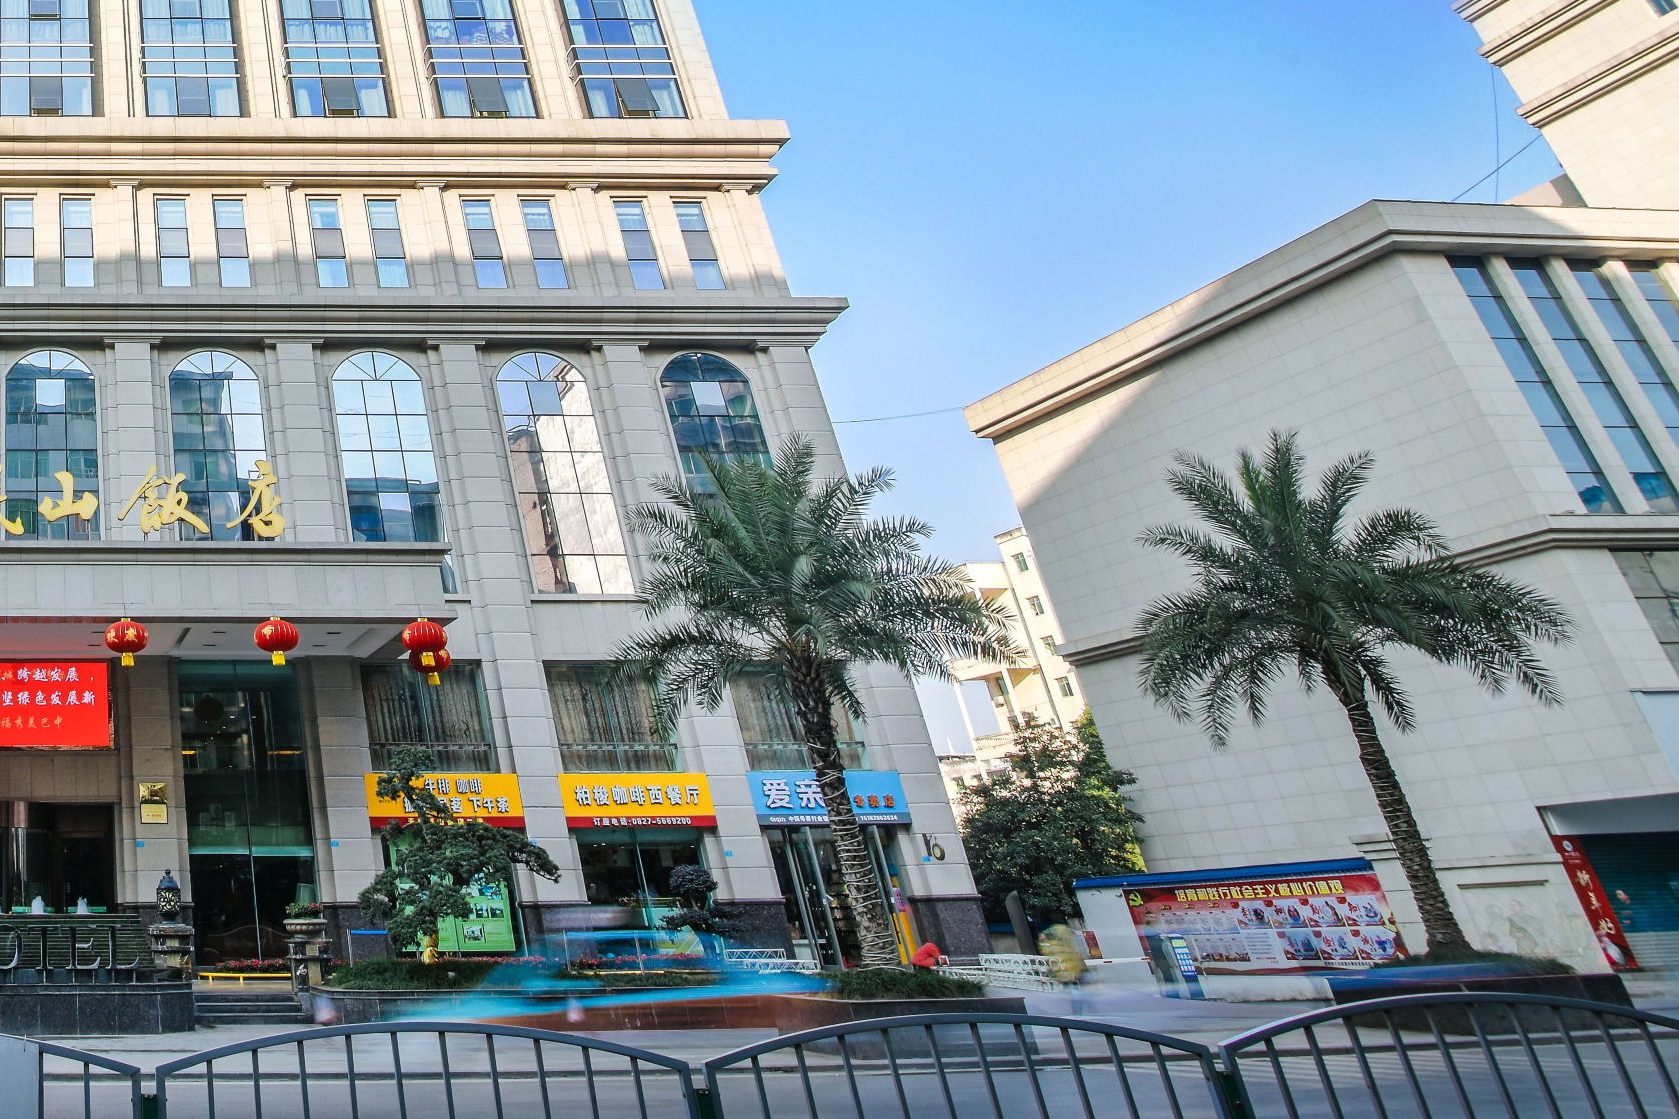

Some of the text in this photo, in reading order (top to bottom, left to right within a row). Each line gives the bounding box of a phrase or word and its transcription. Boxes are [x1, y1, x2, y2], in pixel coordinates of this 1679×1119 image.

[456, 778, 482, 794] 咖啡
[469, 796, 509, 813] 下午茶
[853, 795, 894, 808] 专卖店
[1174, 879, 1344, 902] 培育和践行社会主义核心价值观
